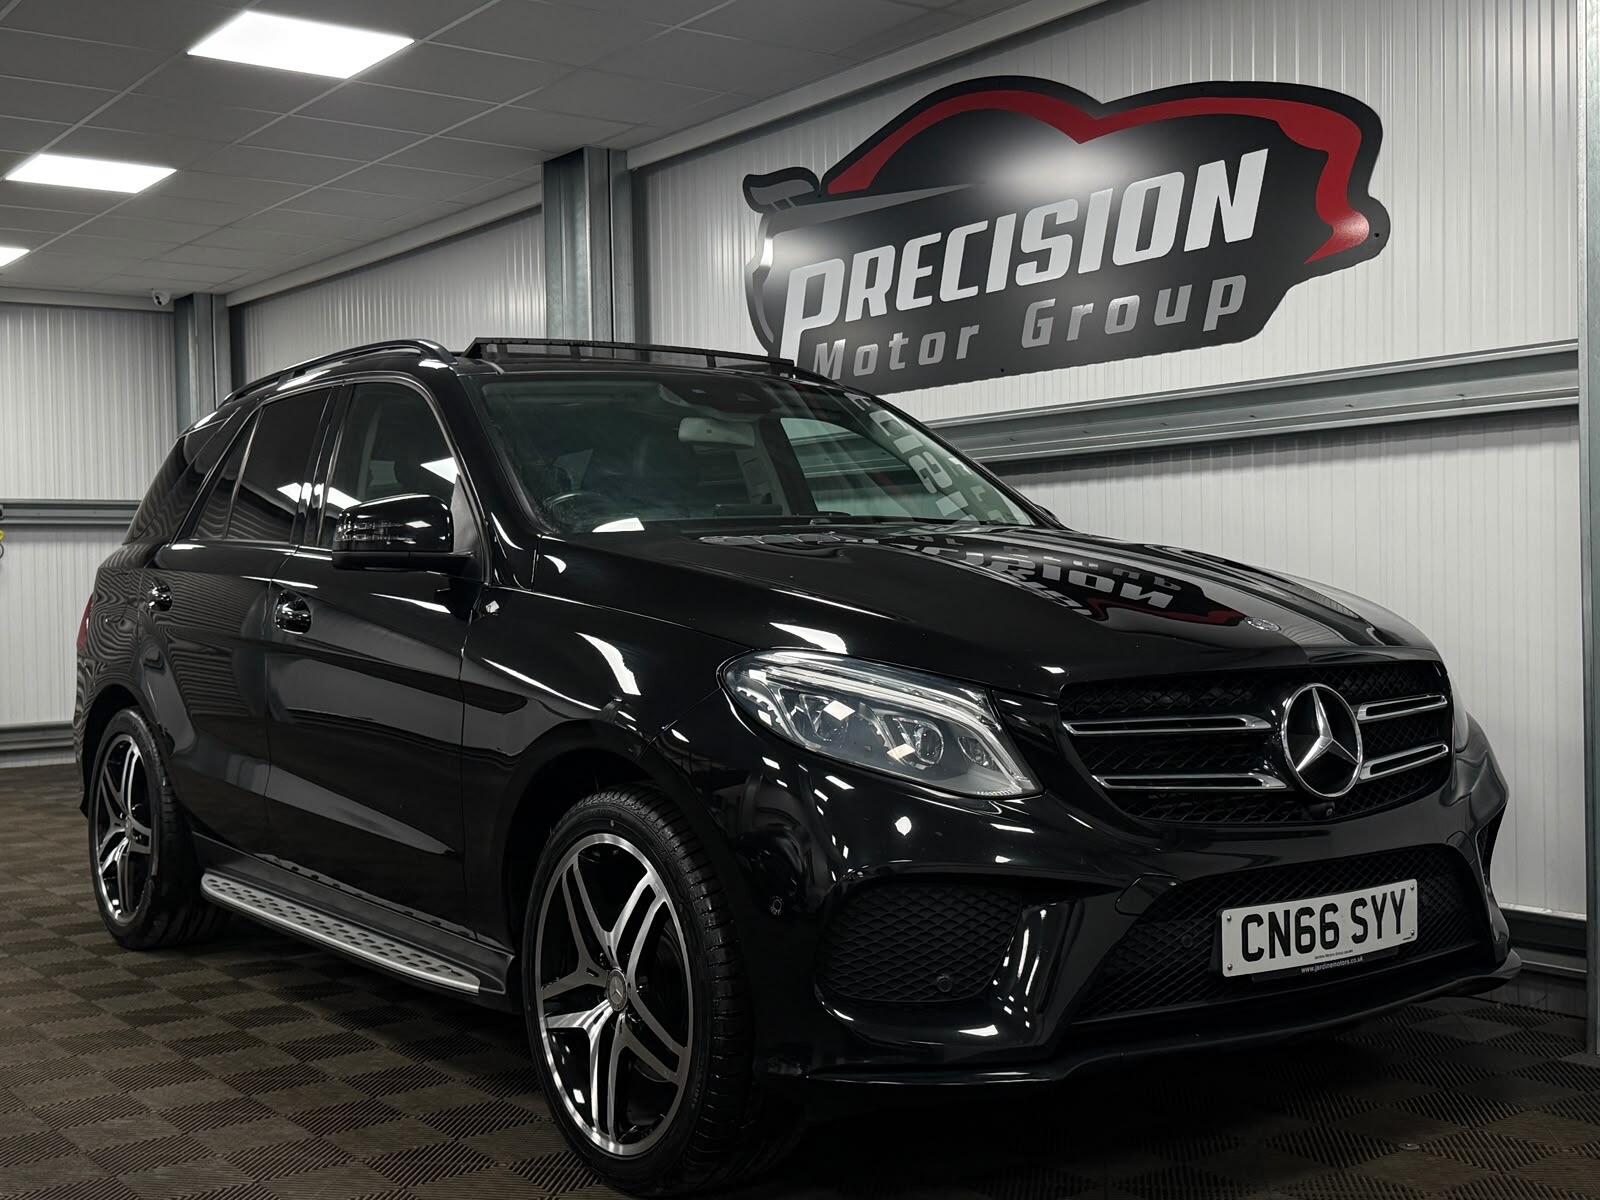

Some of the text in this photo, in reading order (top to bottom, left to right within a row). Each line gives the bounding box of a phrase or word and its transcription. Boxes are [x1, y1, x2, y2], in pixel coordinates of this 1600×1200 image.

[779, 148, 1269, 367] PRECISION
[812, 274, 1247, 381] Motor Group
[1241, 888, 1406, 962] CN66 SYY
[1300, 956, 1364, 974] www.jardinemotors.co.uk
